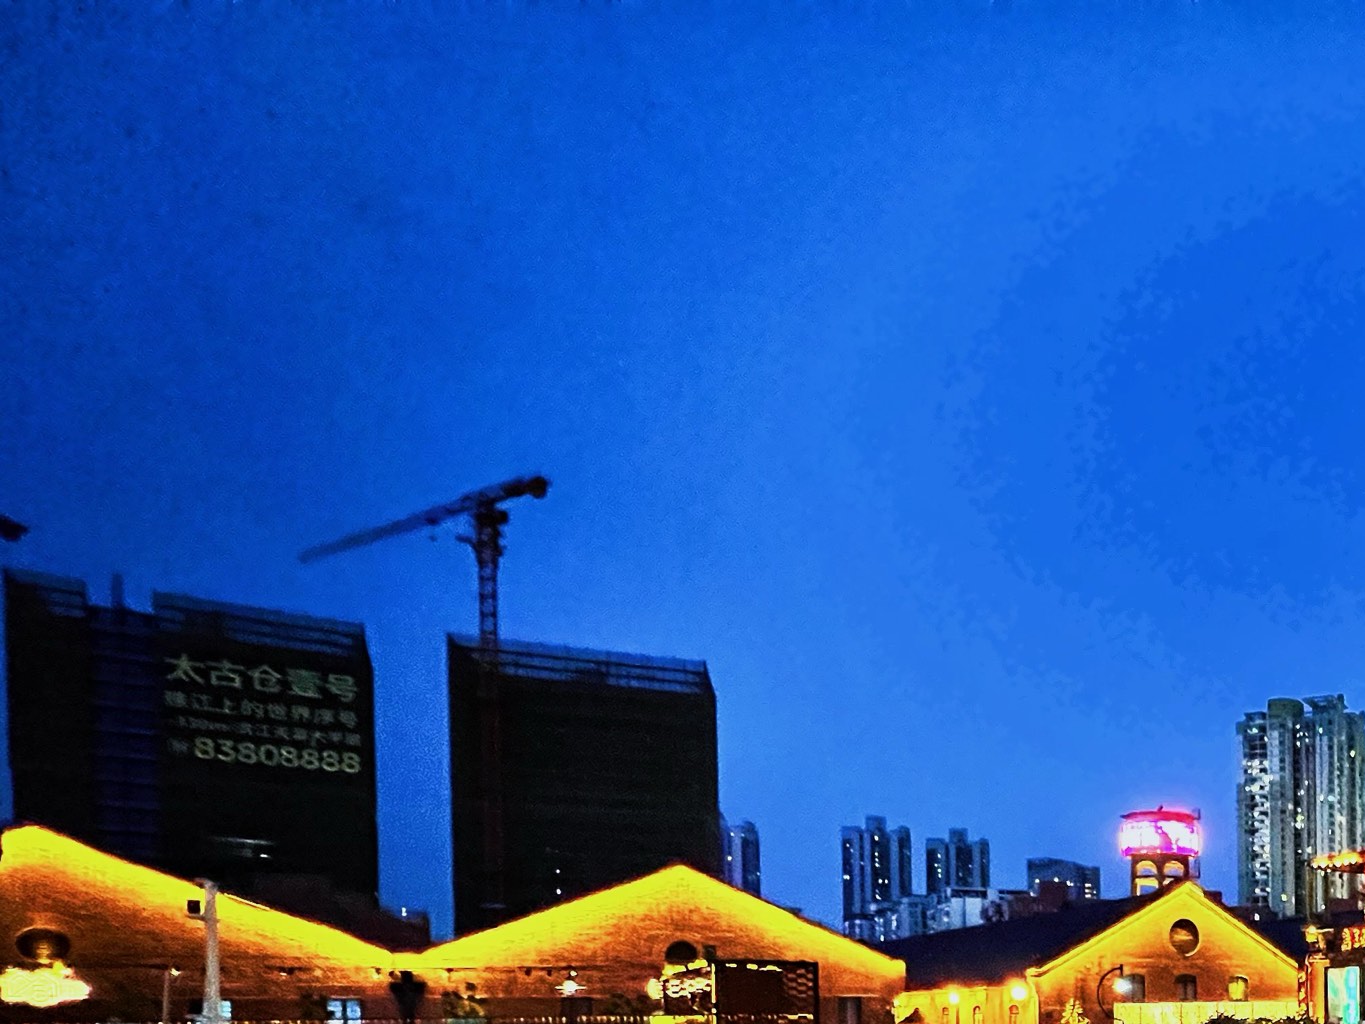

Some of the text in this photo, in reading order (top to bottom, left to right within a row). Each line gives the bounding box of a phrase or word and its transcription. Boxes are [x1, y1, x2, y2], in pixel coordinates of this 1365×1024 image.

[163, 653, 359, 702] 太古仓壹号
[193, 737, 362, 773] 83808888
